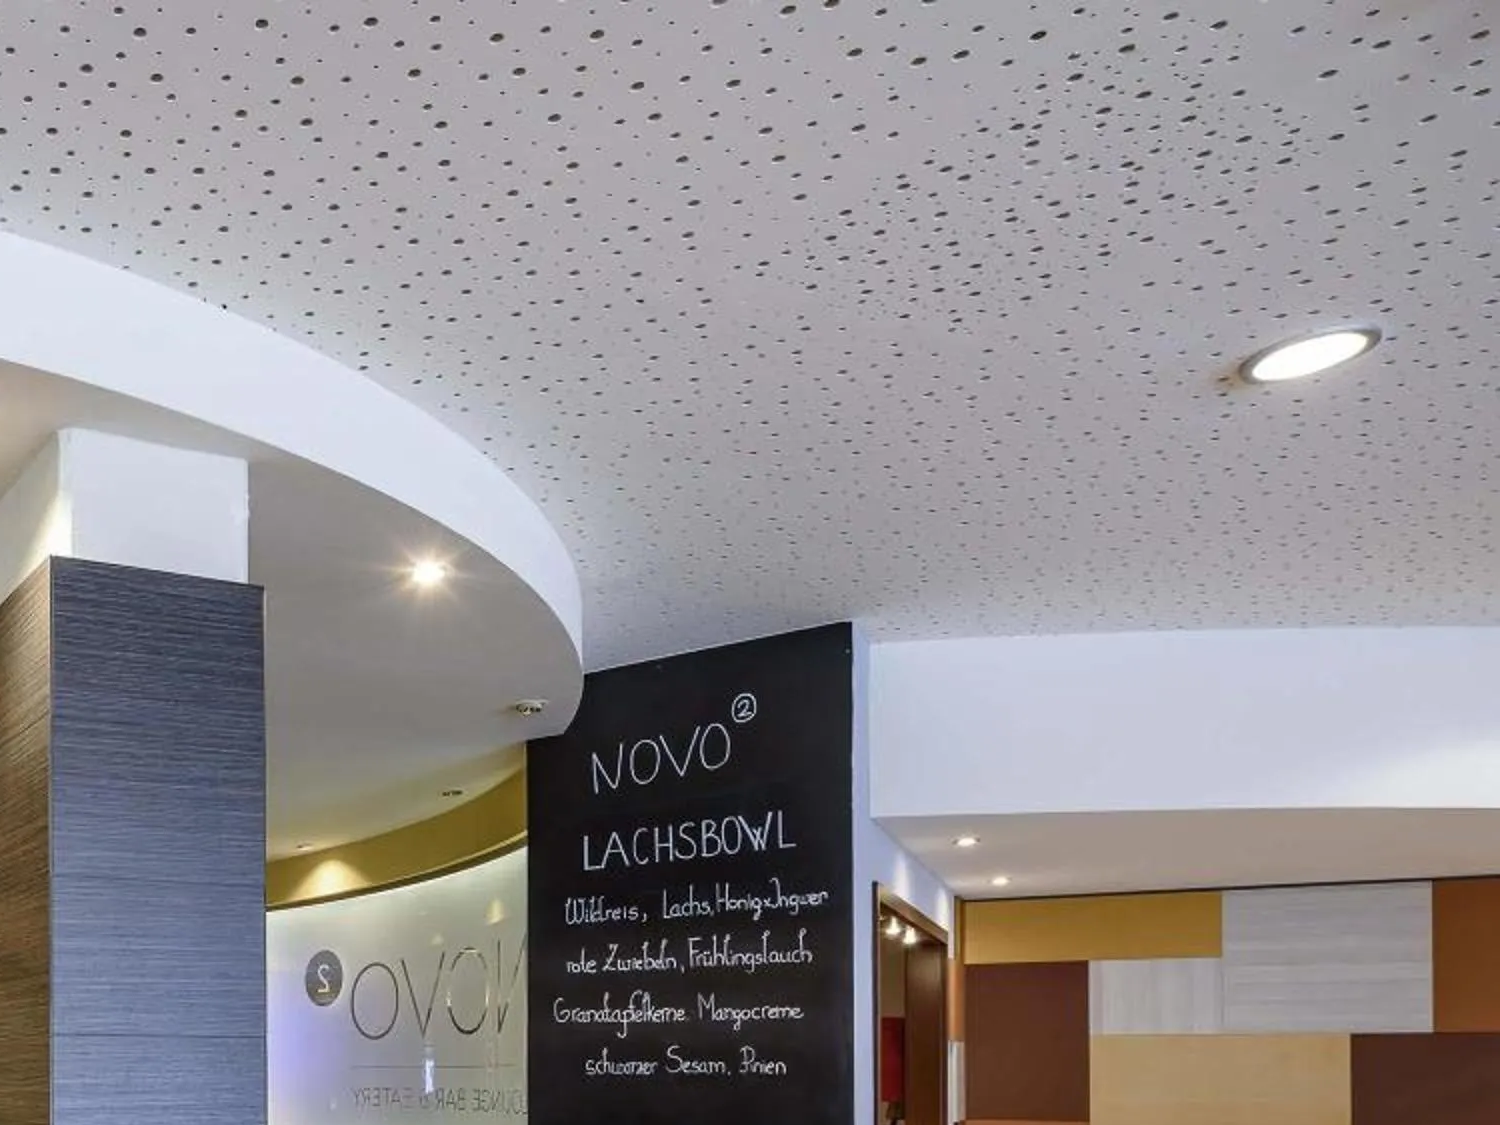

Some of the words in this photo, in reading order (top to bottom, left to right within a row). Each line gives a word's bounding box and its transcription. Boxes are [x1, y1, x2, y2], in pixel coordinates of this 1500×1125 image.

[591, 723, 731, 794] NOVO
[583, 810, 797, 871] LACHSBOWL
[566, 947, 598, 974] rote
